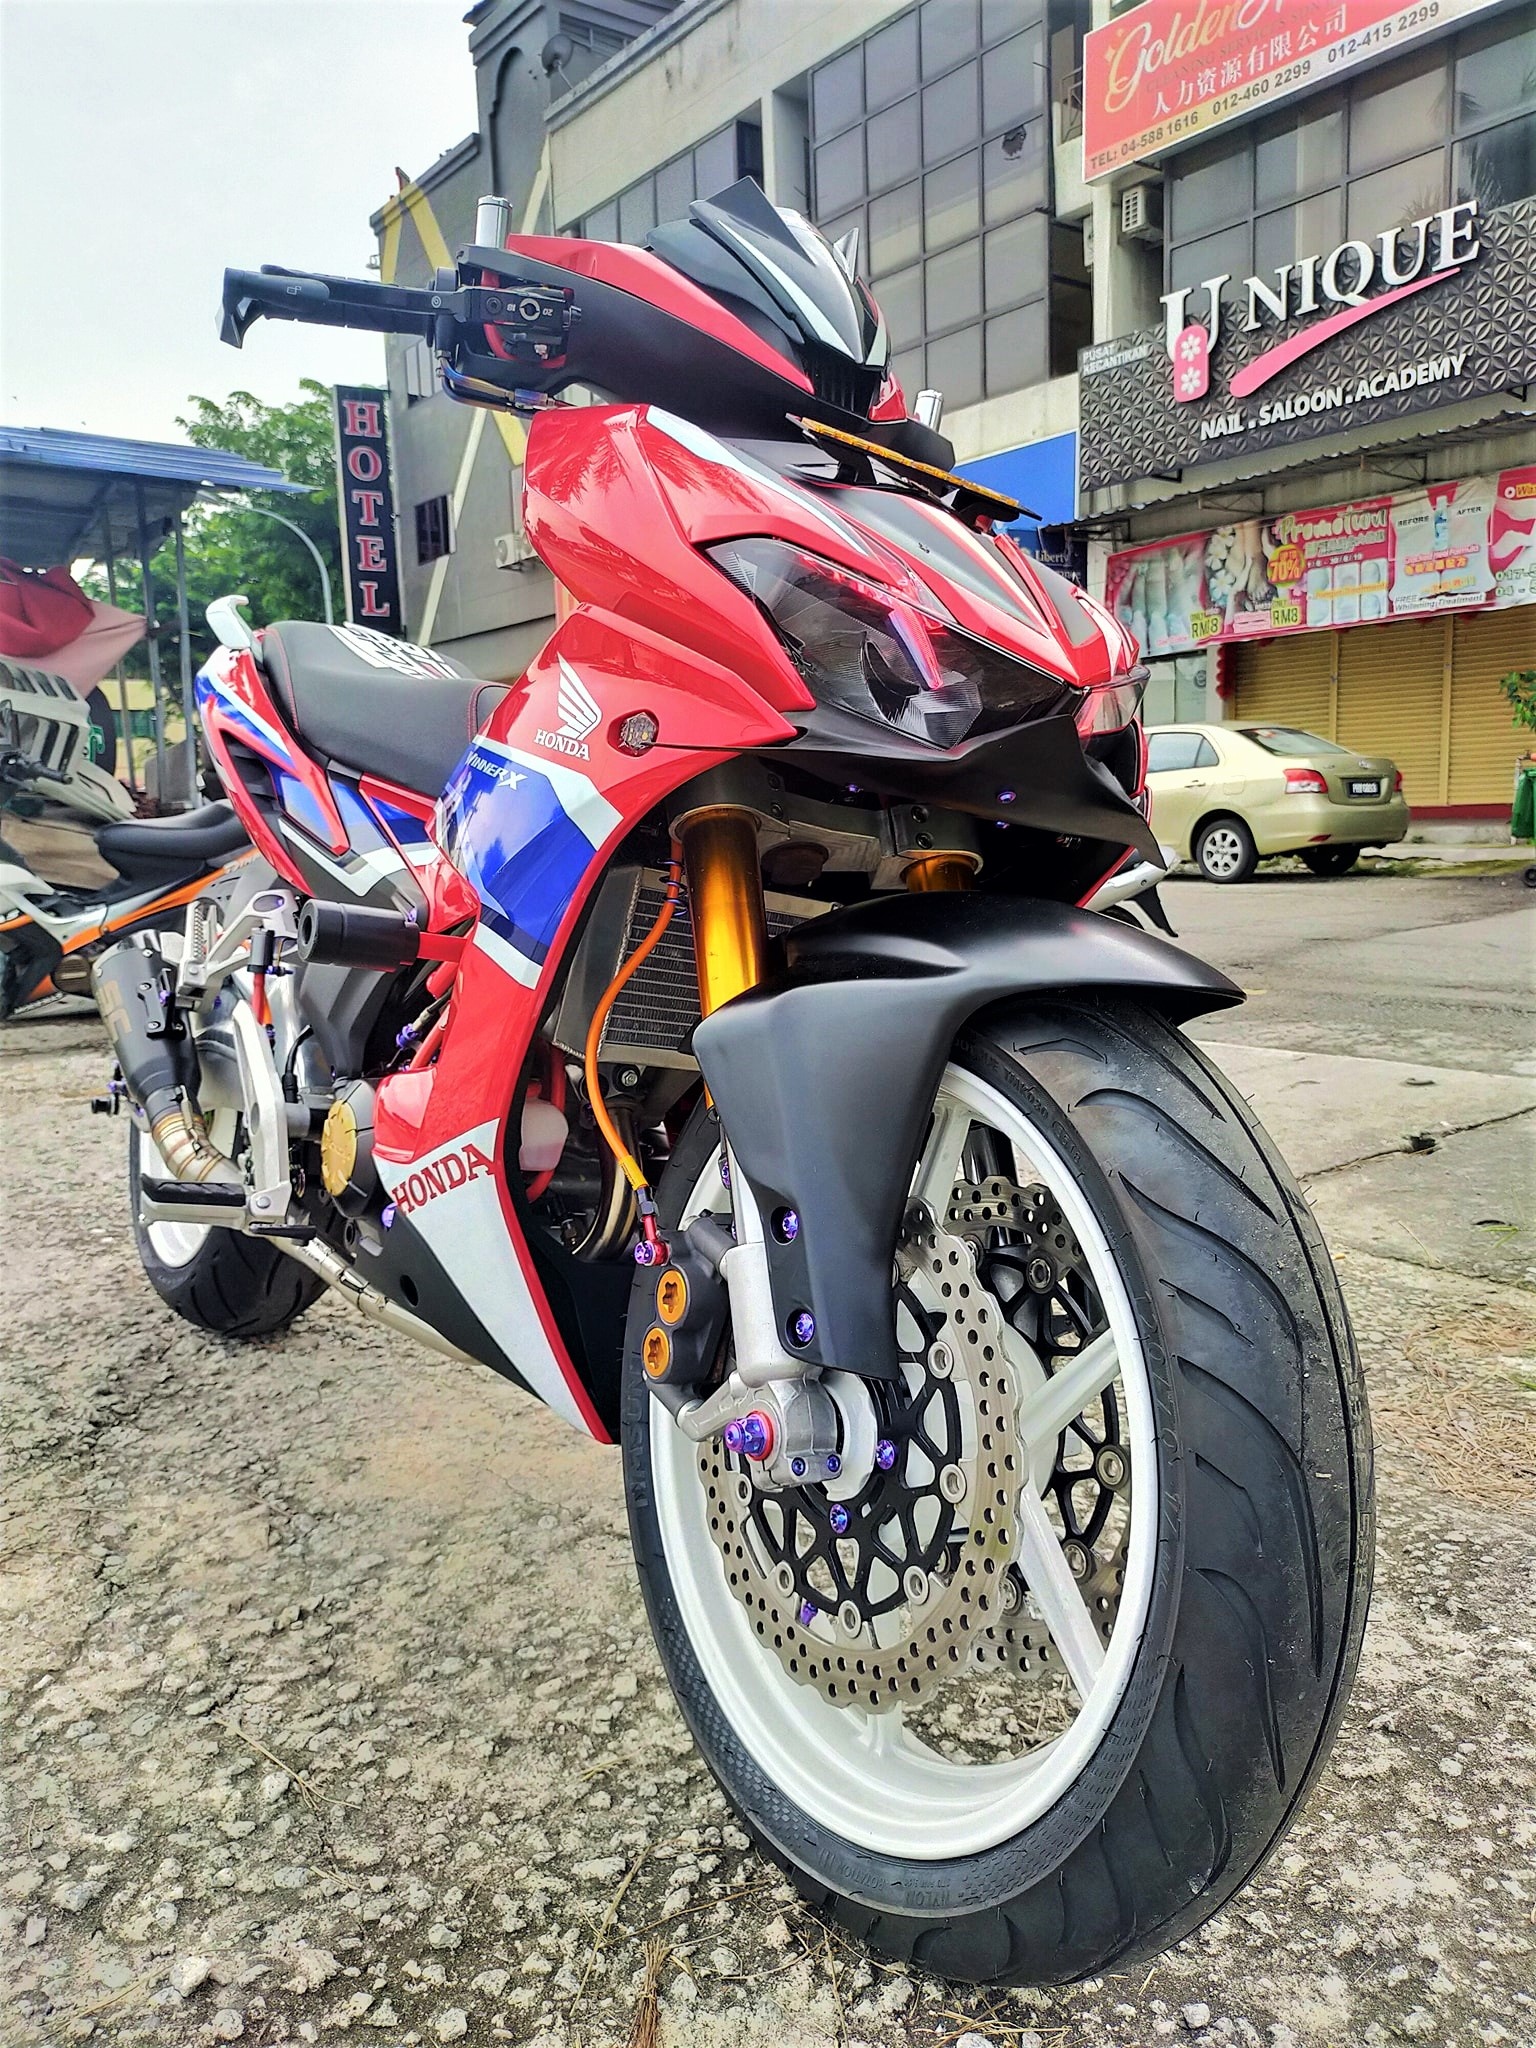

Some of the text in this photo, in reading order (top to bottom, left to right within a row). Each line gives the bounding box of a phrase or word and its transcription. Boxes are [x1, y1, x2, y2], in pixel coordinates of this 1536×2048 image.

[1091, 2, 1440, 169] TEL: 04-588 1616 012-460 2299 012-415 2299
[1105, 0, 1241, 113] Golden
[1160, 199, 1481, 363] UNIQUE
[1201, 352, 1472, 442] NAIL SALOON ACADEMY
[344, 399, 391, 618] HOTEL
[1397, 514, 1430, 527] BEFORE
[1456, 505, 1483, 516] AFTER
[1272, 607, 1298, 626] RM8
[533, 728, 591, 762] HONDA
[391, 1143, 497, 1214] HONDA
